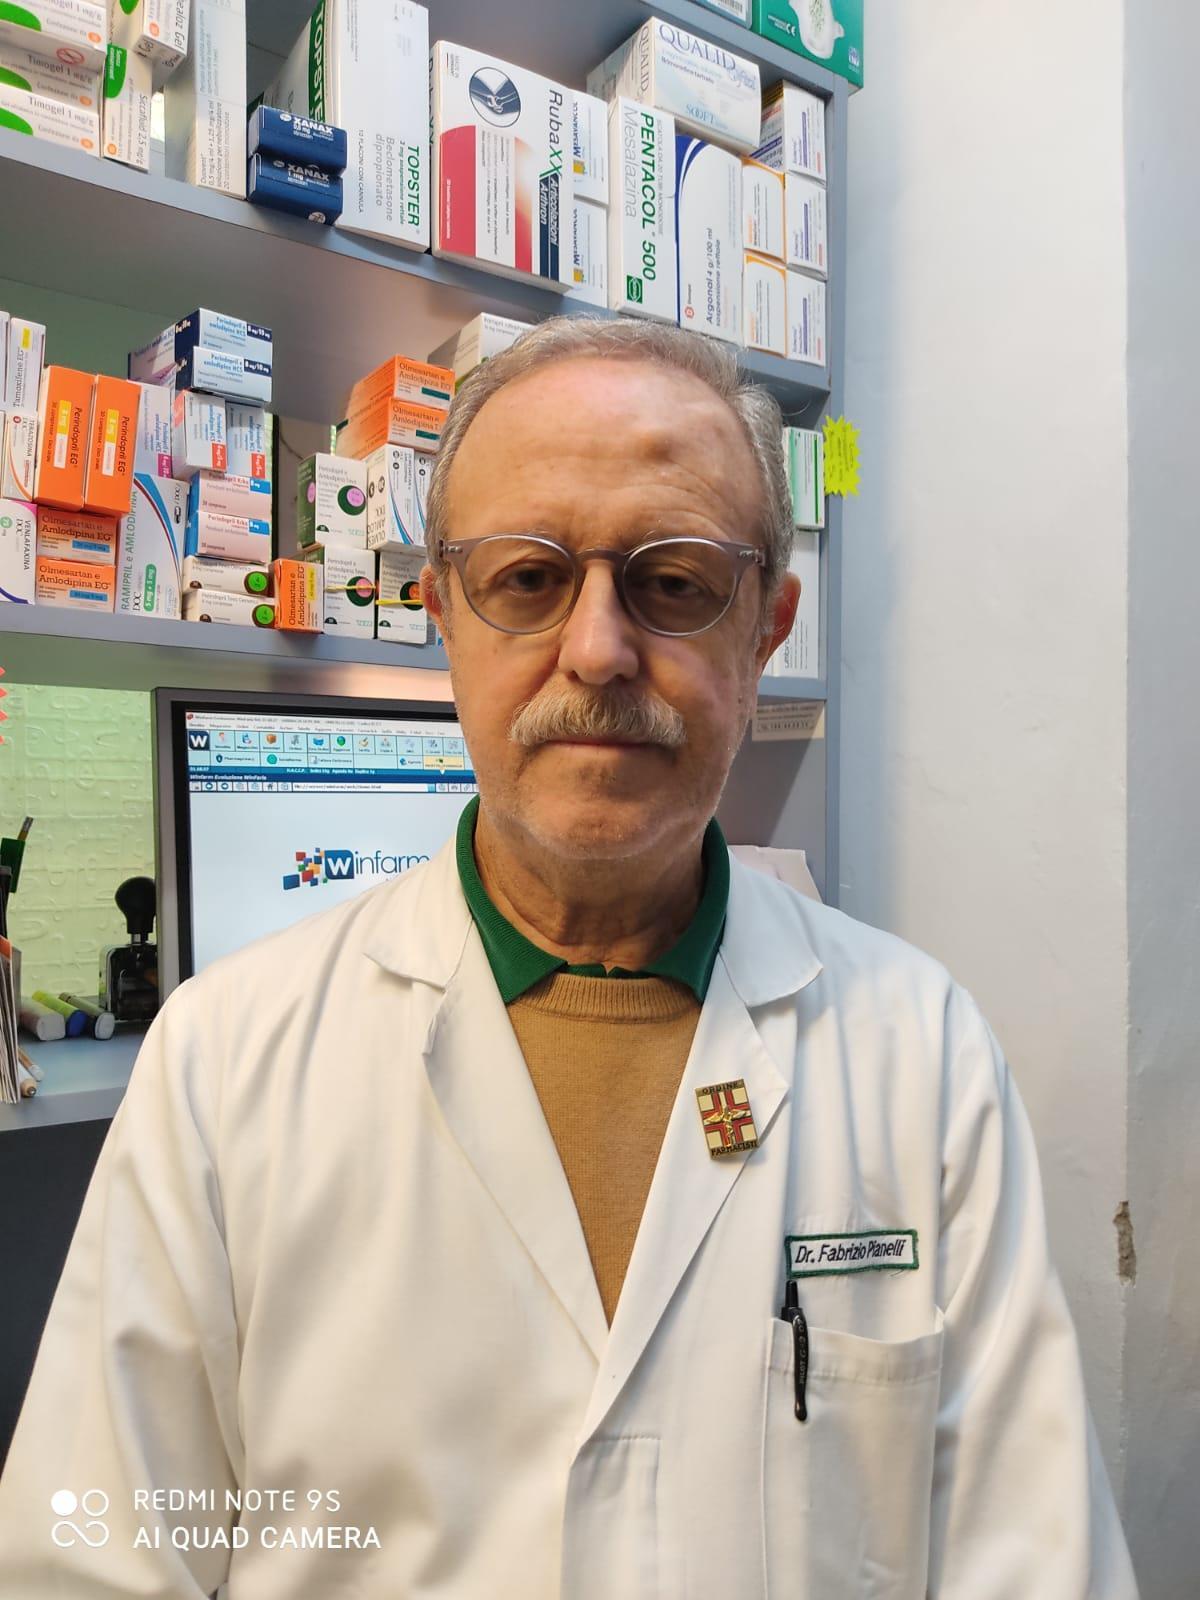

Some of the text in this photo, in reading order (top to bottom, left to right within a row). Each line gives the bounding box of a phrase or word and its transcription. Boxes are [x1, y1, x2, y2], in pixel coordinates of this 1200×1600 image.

[639, 25, 650, 92] QUALID
[659, 24, 737, 71] QUALID
[27, 54, 64, 74] Timogel
[314, 3, 324, 121] TOPSTE
[27, 95, 65, 116] Timogel
[294, 117, 334, 134] XANAX
[287, 163, 330, 181] XANAX
[373, 133, 385, 207] dipropionato
[624, 106, 640, 219] Mesalazina
[408, 146, 420, 227] TOPSTER
[641, 112, 656, 281] PENTACOL 500
[13, 361, 24, 408] Tamoxifene
[399, 363, 440, 381] Olmesartan
[392, 405, 434, 421] Olmesartan
[71, 407, 82, 451] Perindopril
[118, 416, 130, 460] Perindopril
[41, 524, 95, 540] Amlodipina
[42, 515, 96, 529] Olmesartan
[23, 520, 31, 570] VENLAFAXINA
[39, 565, 93, 579] Olmesartan
[39, 574, 110, 590] Amlodipina EG
[121, 564, 133, 611] RAMIPRIL
[133, 592, 141, 612] DOC
[288, 580, 296, 626] Olmesartan
[297, 580, 307, 627] Amlodipina
[190, 735, 208, 748] W
[702, 1082, 738, 1095] ORDINE
[711, 1140, 758, 1156] FARMACISTI
[795, 1238, 908, 1264] Dr. Fabrizio Pianelli
